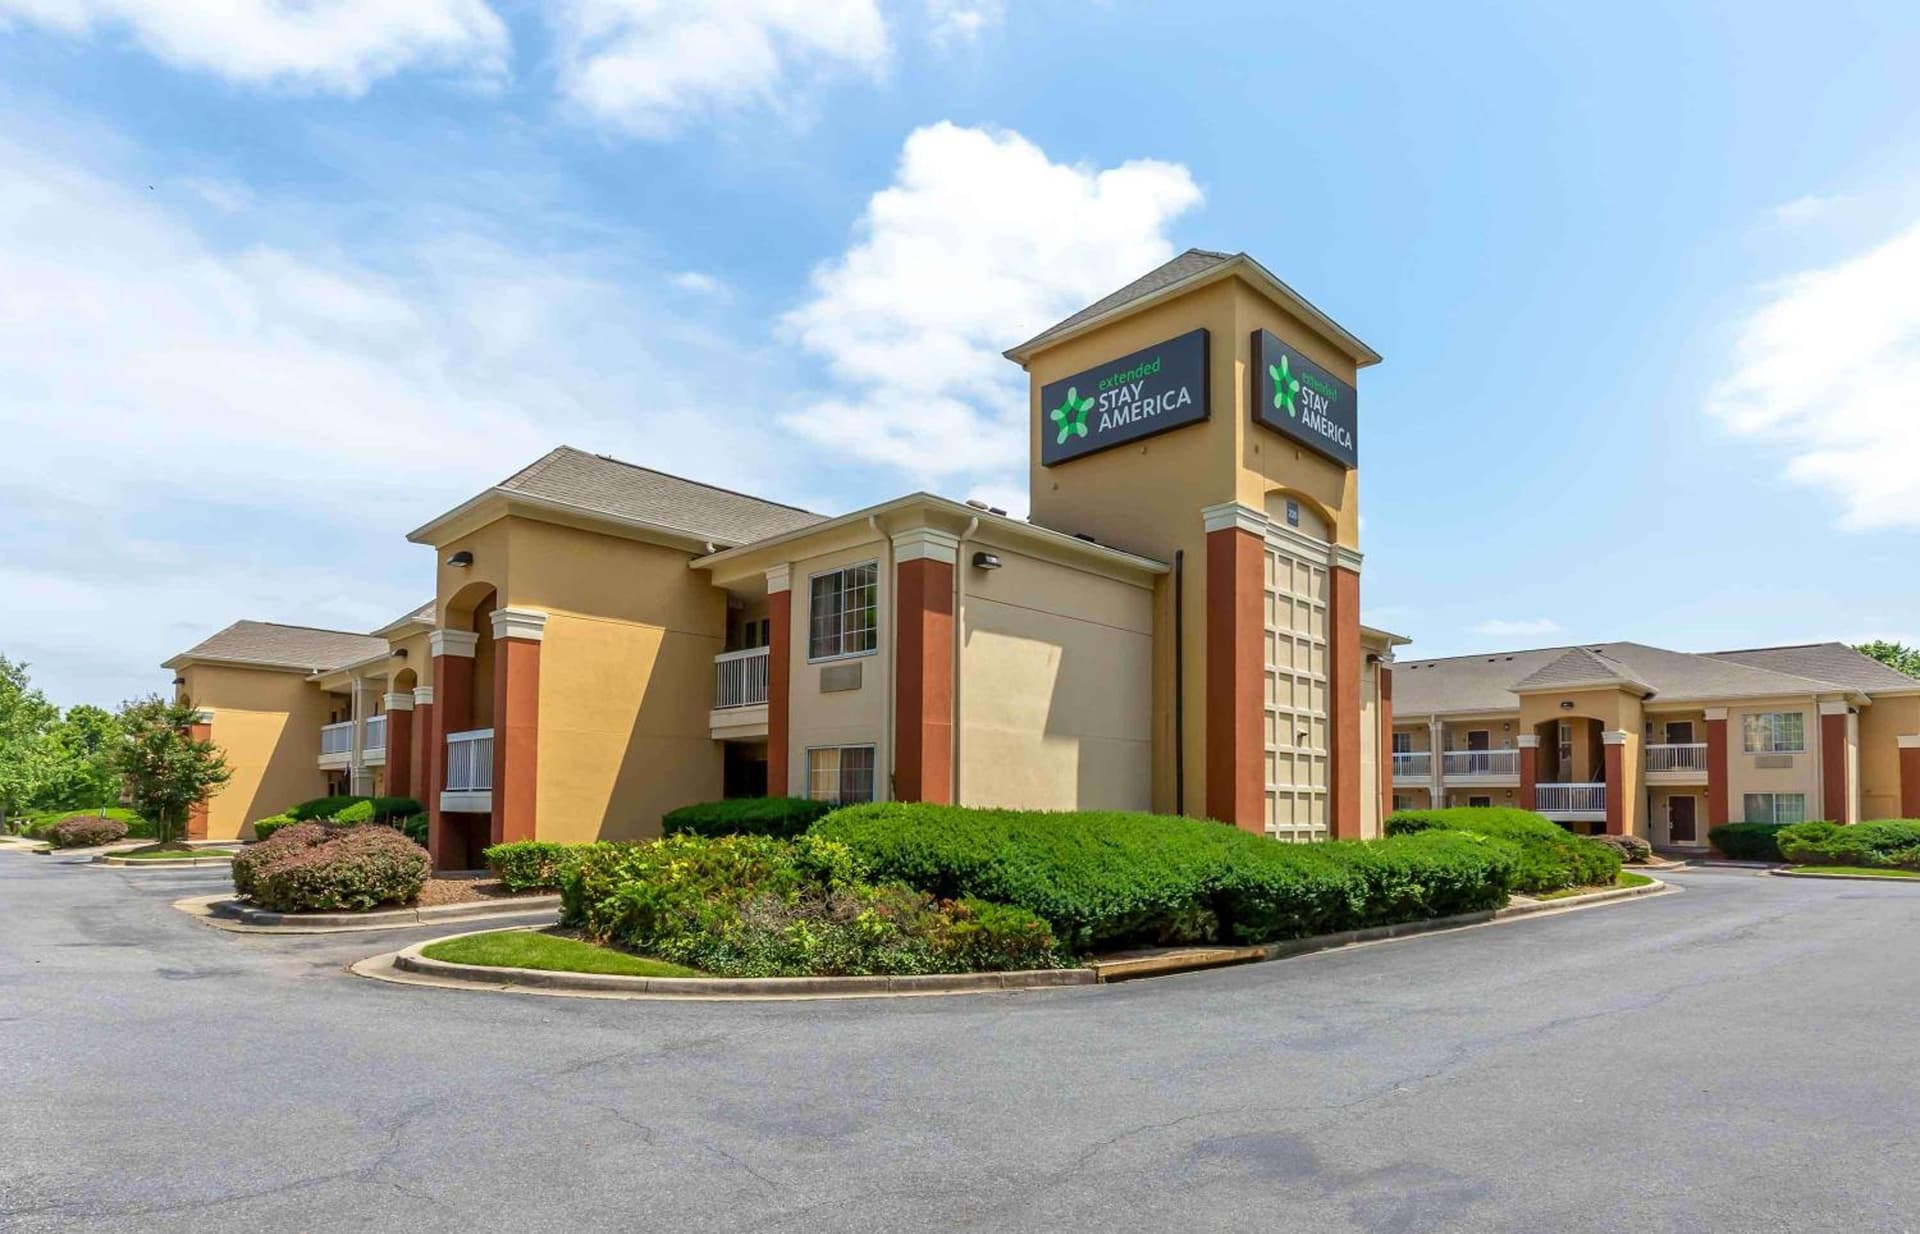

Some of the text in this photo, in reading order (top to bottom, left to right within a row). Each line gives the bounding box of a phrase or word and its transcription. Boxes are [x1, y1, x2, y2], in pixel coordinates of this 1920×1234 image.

[1099, 357, 1161, 391] extended
[1099, 380, 1144, 412] STAY
[1302, 386, 1329, 416] STAY
[1098, 396, 1192, 432] AMERICA
[1302, 407, 1353, 450] AMERICA
